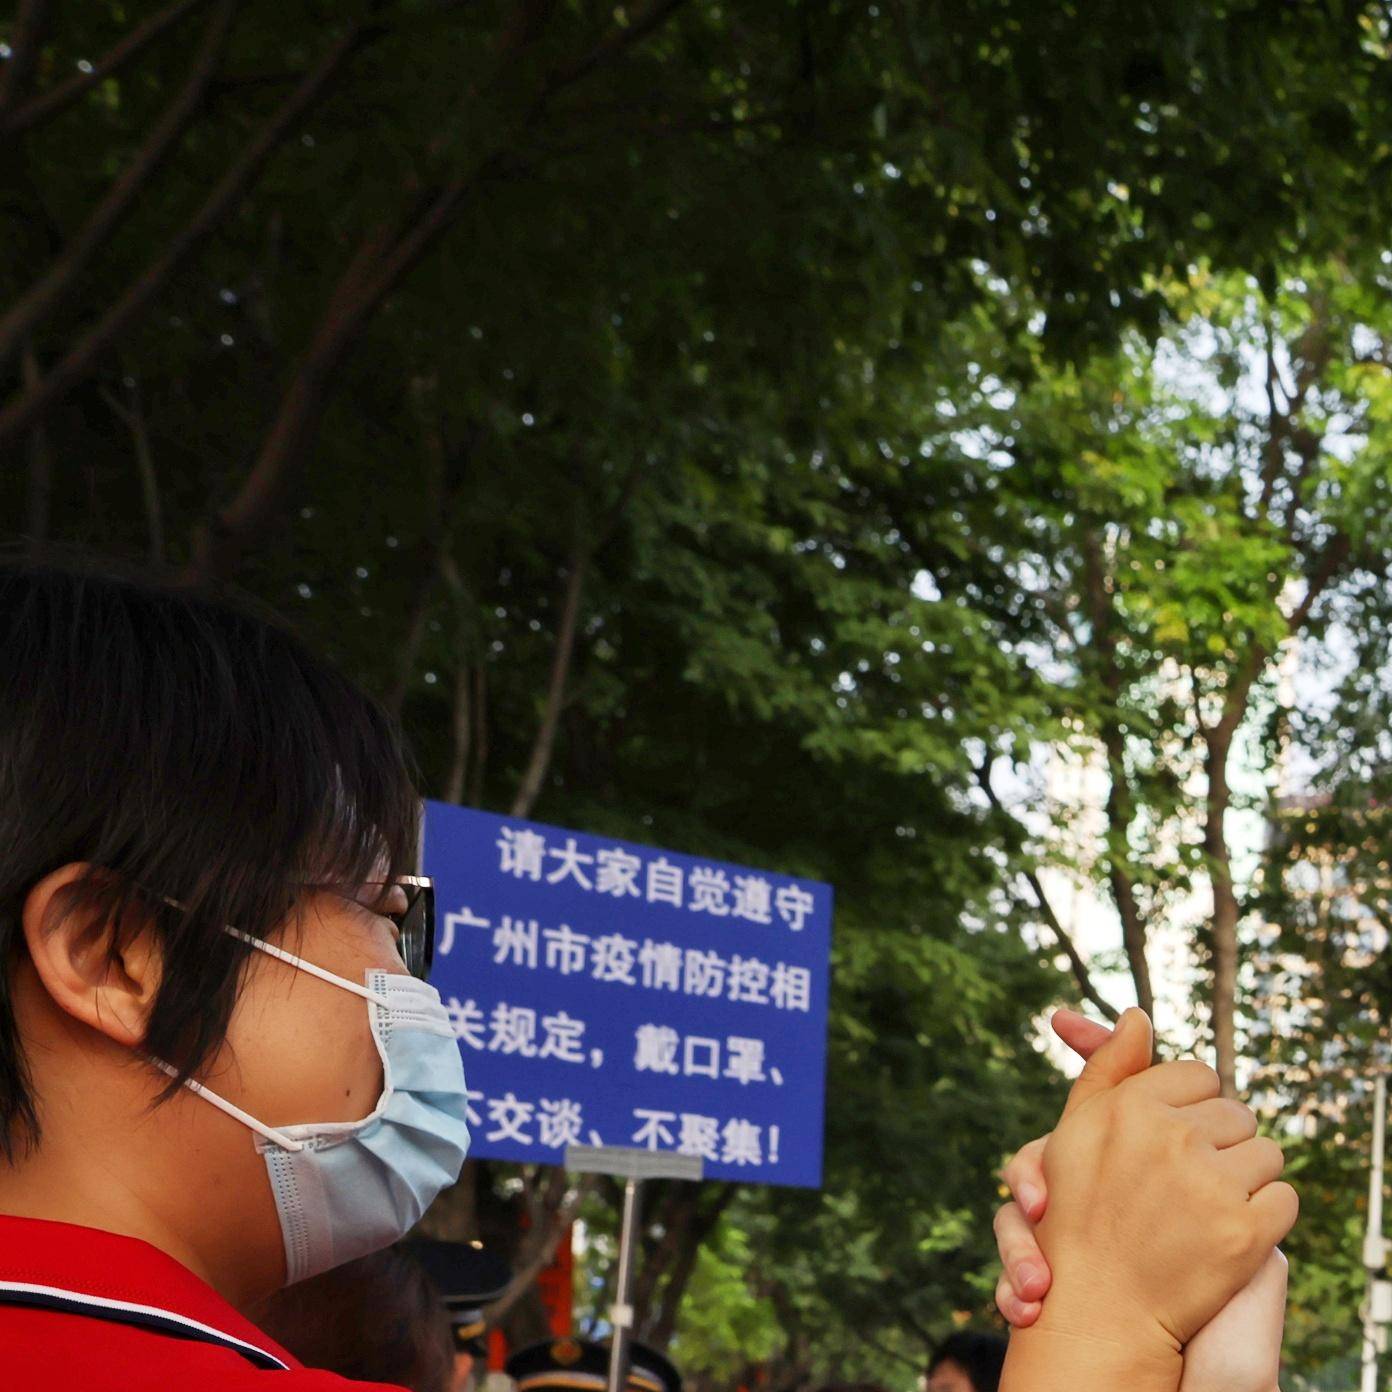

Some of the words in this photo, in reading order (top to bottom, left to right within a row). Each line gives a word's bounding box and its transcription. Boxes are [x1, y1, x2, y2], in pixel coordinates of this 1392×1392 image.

[496, 826, 815, 930] 请大家自觉遵守
[439, 908, 811, 1012] 广州市疫情防控相
